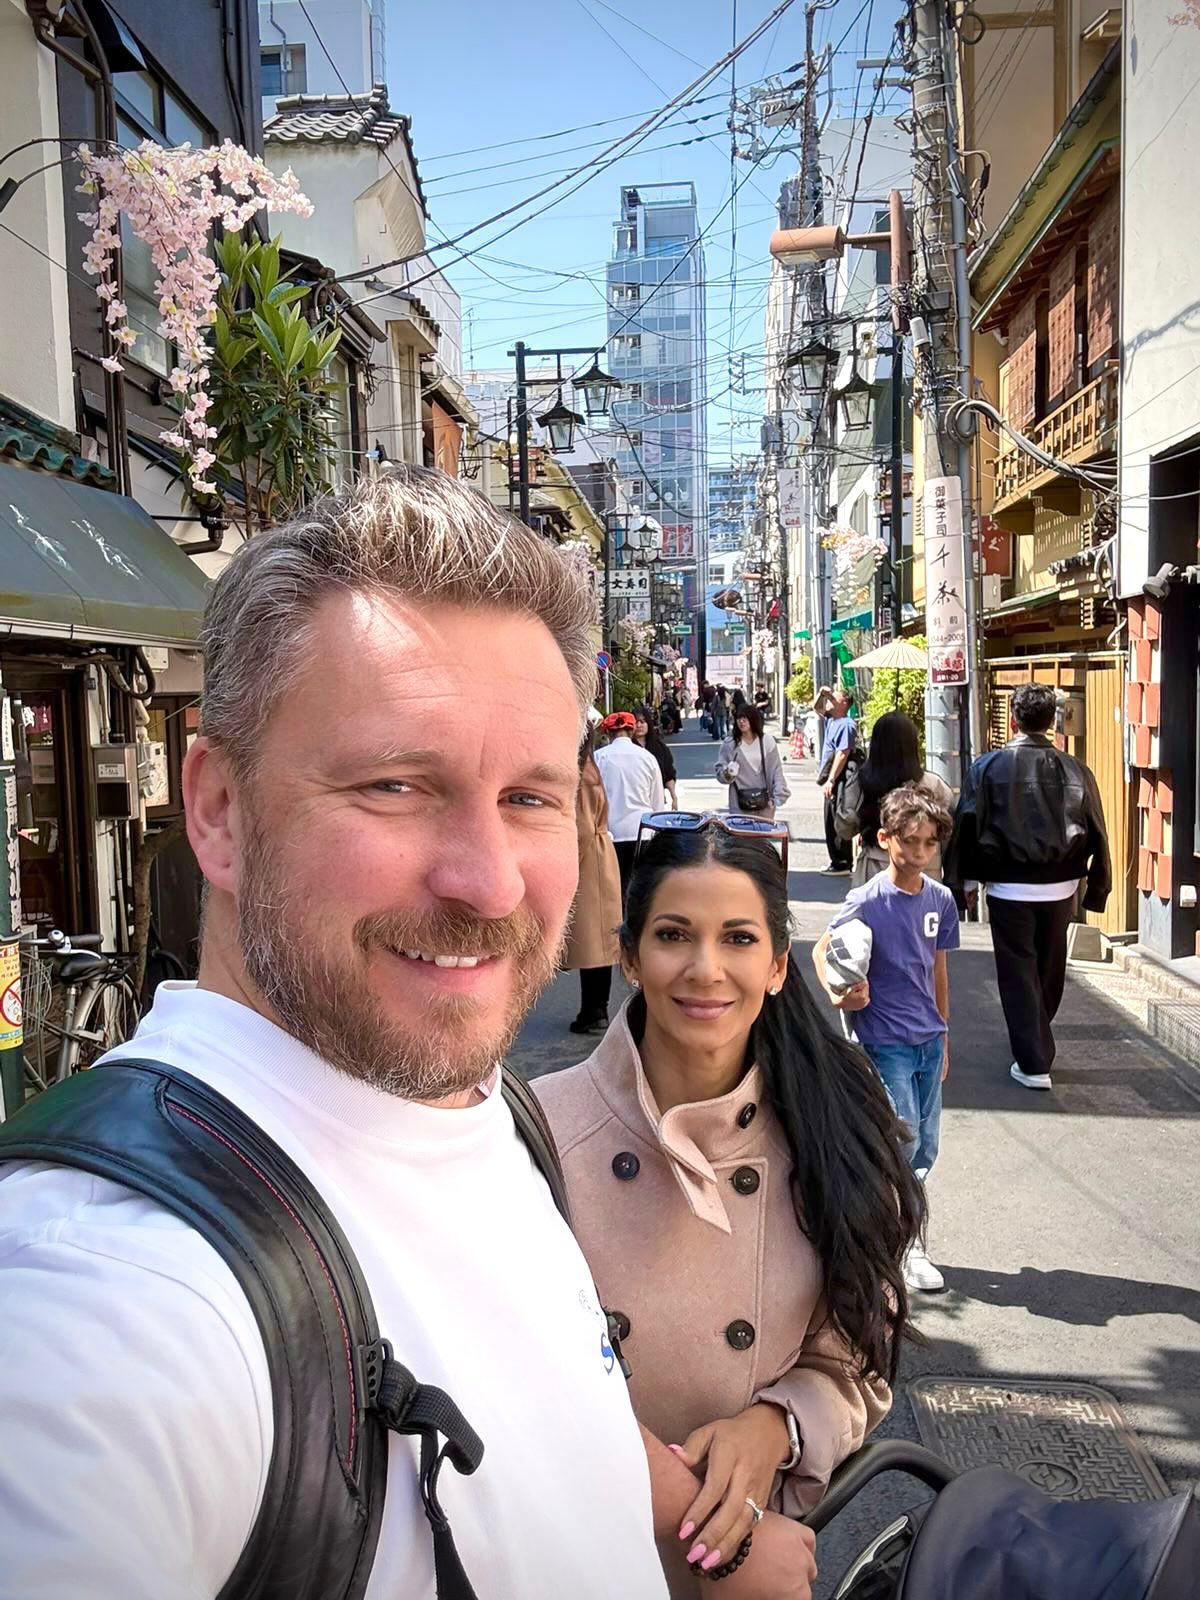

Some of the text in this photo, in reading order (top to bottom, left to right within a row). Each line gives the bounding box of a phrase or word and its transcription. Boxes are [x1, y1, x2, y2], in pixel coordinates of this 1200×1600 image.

[935, 486, 947, 537] 御菓子司
[924, 912, 939, 937] G
